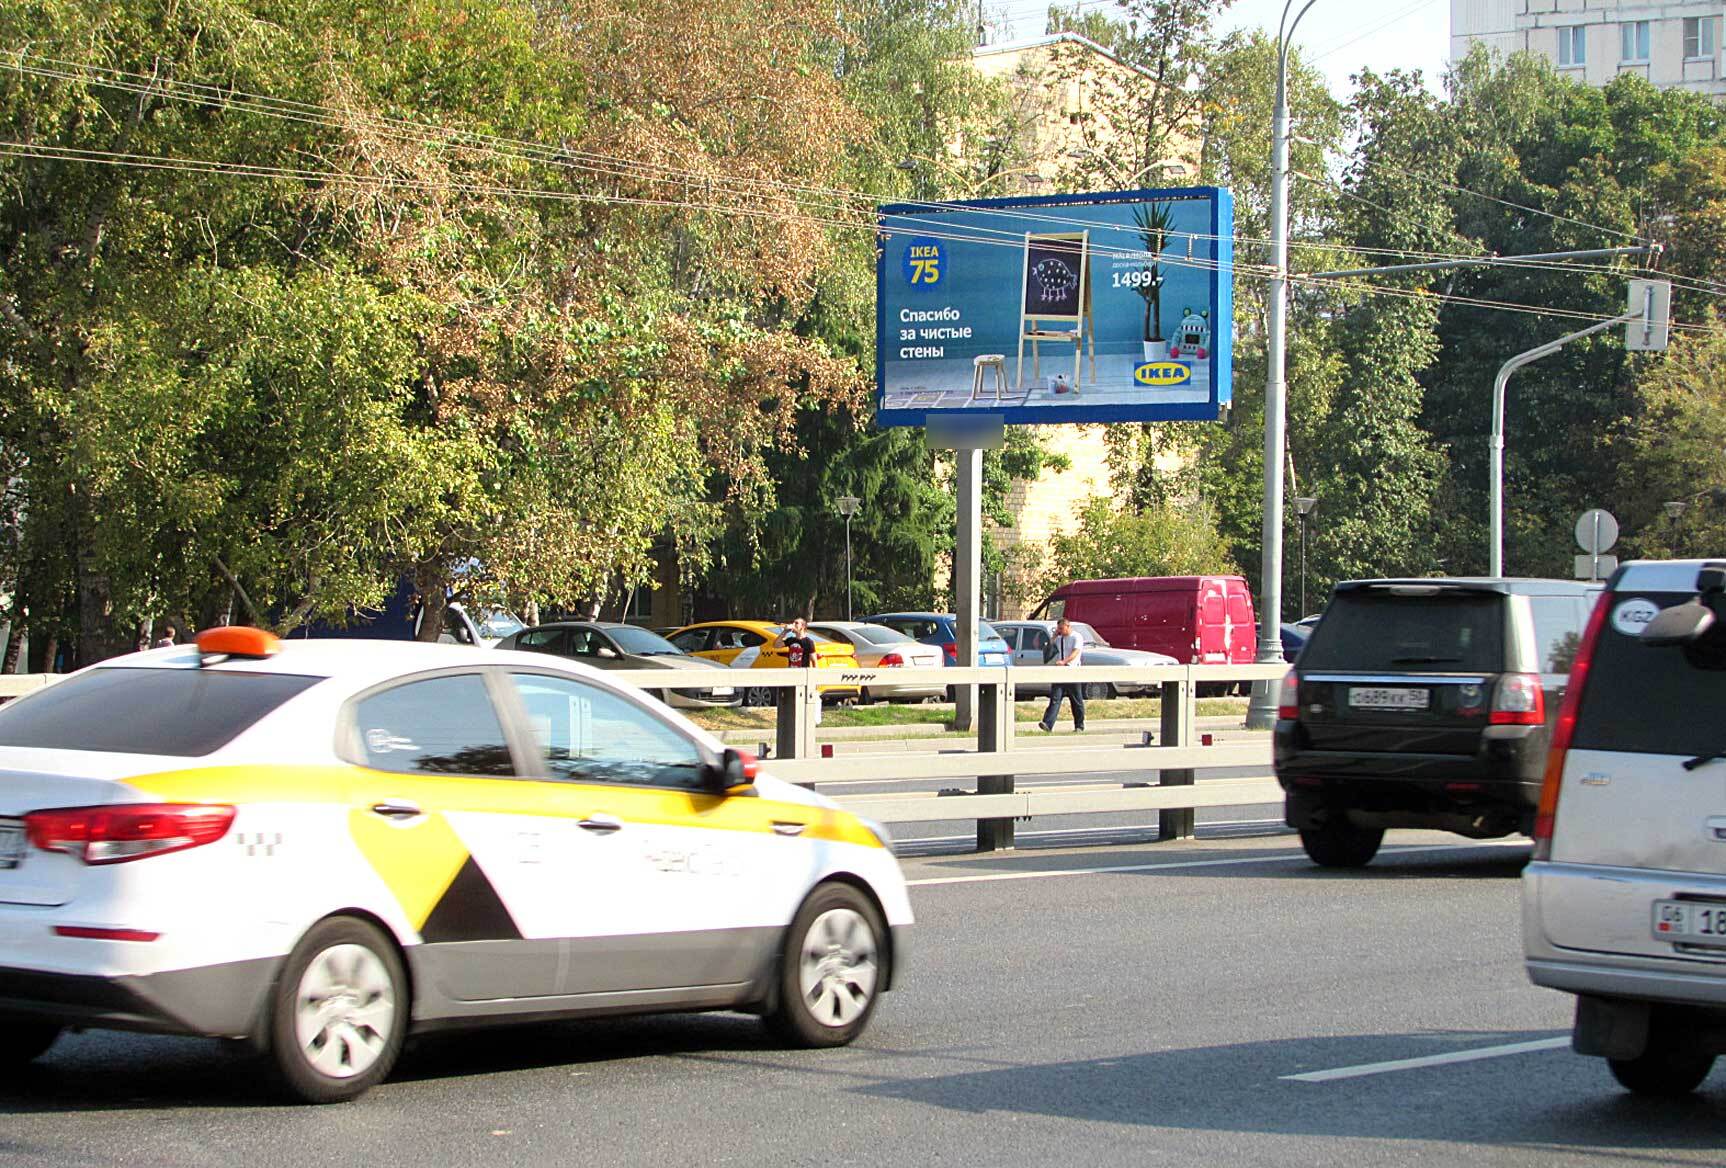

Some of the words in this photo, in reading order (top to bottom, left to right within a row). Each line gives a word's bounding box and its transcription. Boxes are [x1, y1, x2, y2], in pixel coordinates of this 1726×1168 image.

[910, 246, 939, 258] IKEA
[910, 259, 939, 284] 75
[900, 307, 960, 322] Спасибо
[900, 328, 916, 340] за
[920, 327, 972, 340] чистые
[900, 346, 944, 358] стены
[1141, 367, 1185, 379] IKEA
